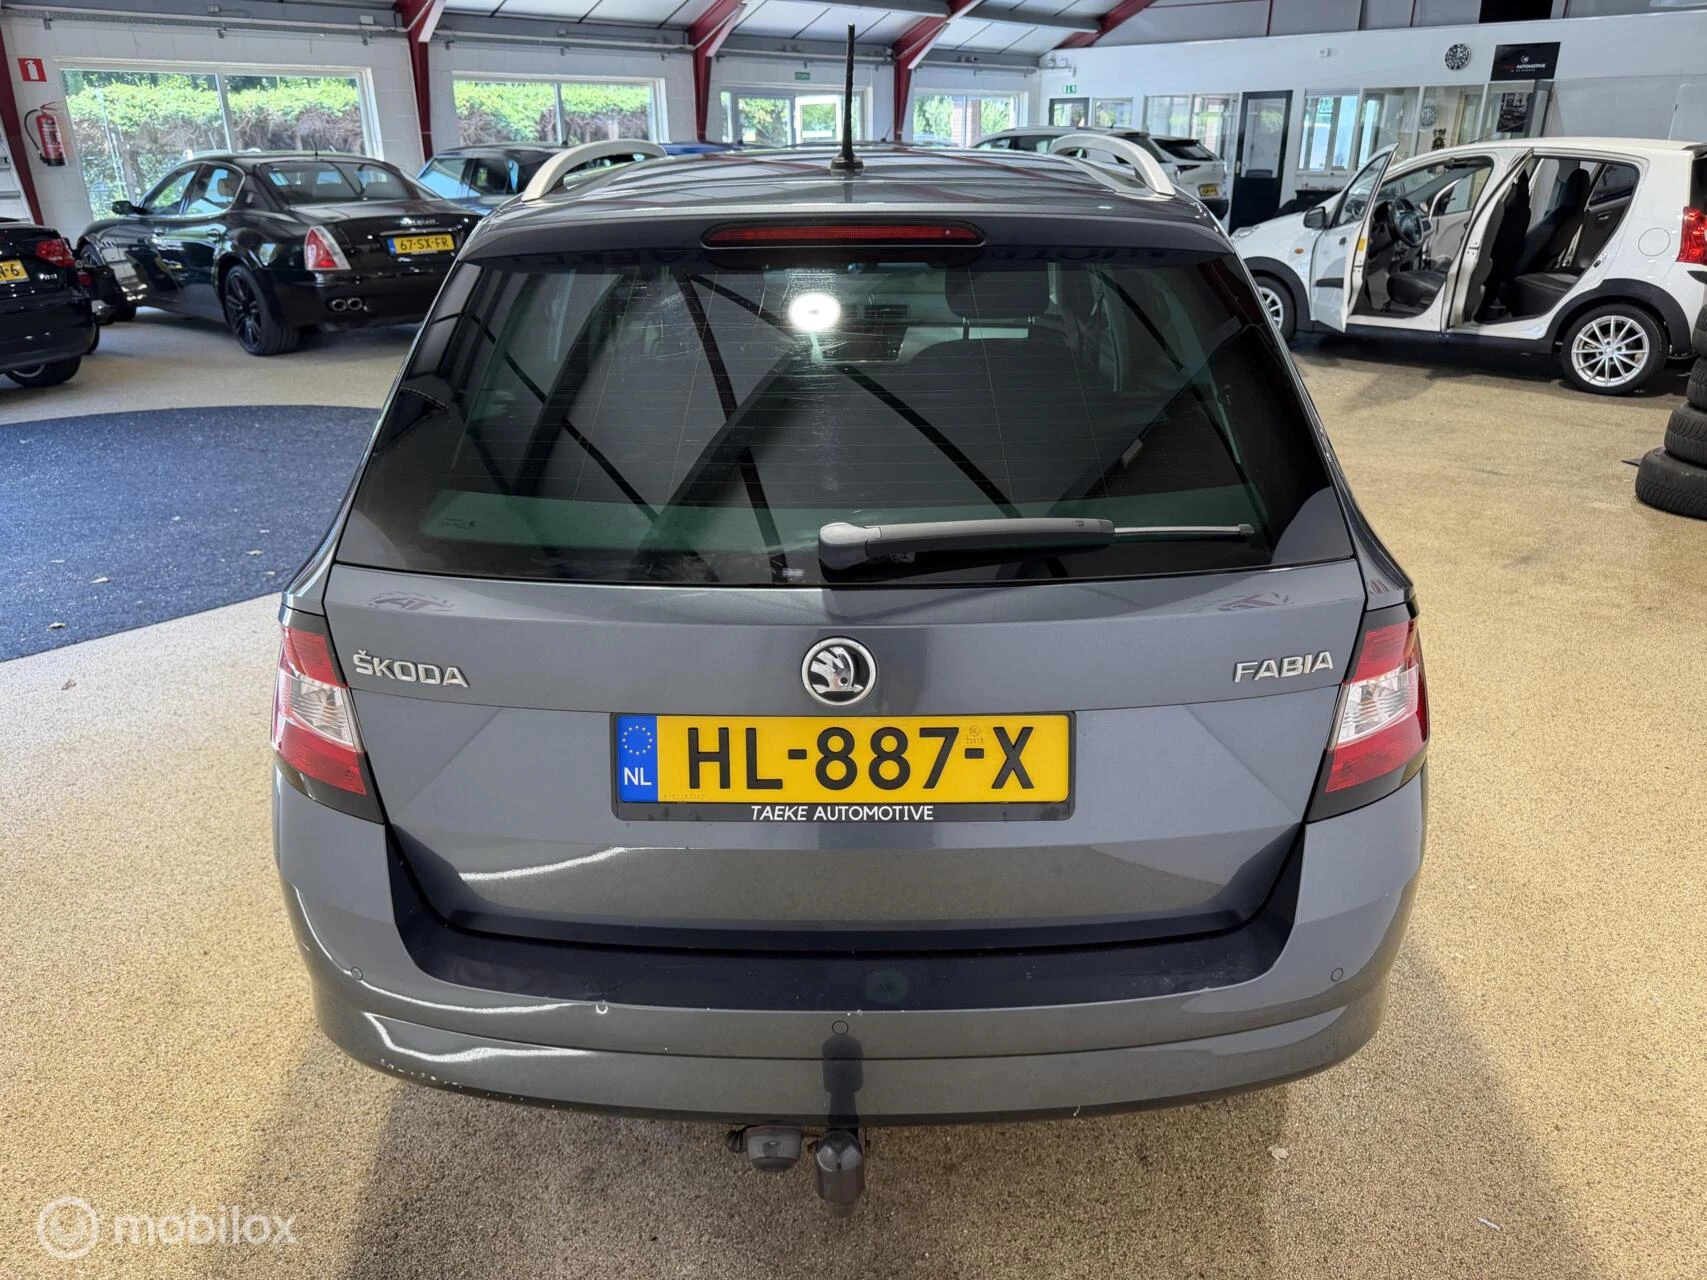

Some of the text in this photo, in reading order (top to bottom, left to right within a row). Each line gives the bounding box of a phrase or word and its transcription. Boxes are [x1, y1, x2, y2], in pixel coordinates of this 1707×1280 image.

[353, 649, 470, 688] ŠKODA
[1233, 650, 1334, 683] FABIA
[623, 727, 1035, 790] NL HL-887-X
[751, 806, 934, 821] TAEKE AUTOMOTIVE
